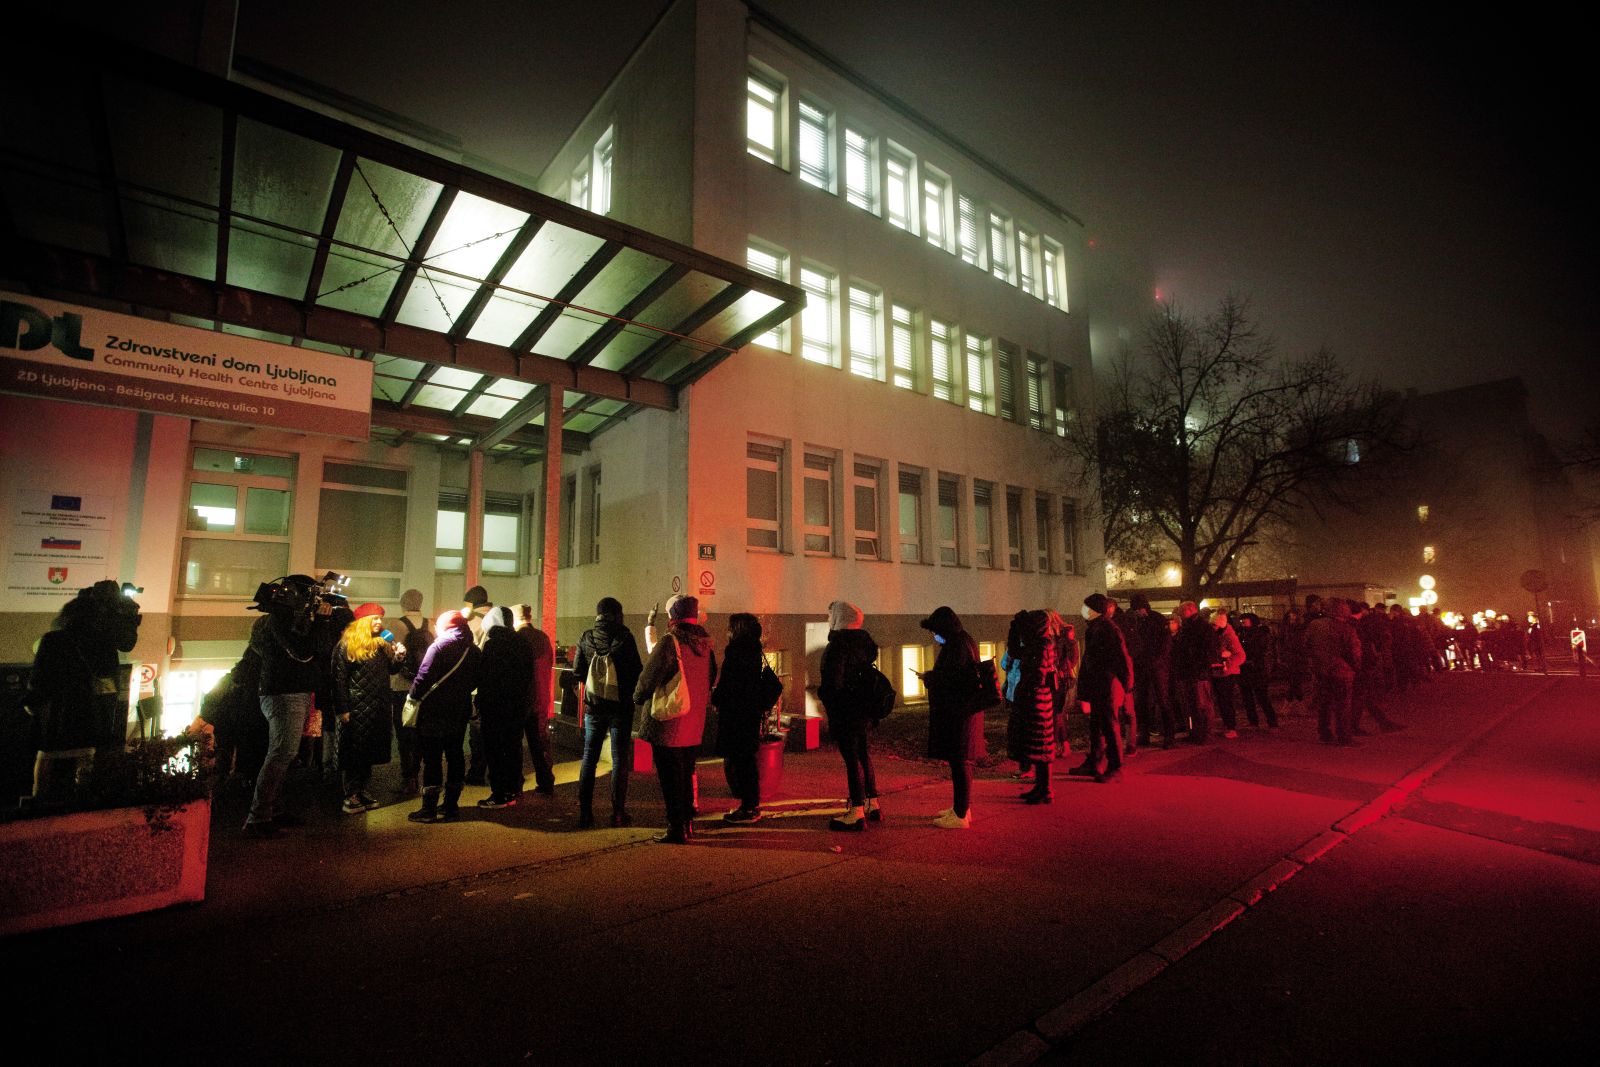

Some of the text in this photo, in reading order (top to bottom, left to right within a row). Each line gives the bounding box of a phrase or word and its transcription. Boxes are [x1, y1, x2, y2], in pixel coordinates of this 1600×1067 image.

[103, 354, 337, 401] Community Health Centre Ljubljana
[105, 335, 337, 387] Zdravstveni dom Ljubljana
[41, 373, 106, 392] Ljubljana
[116, 385, 177, 403] Bežigrad,
[232, 402, 258, 414] ulica
[262, 406, 275, 416] 10
